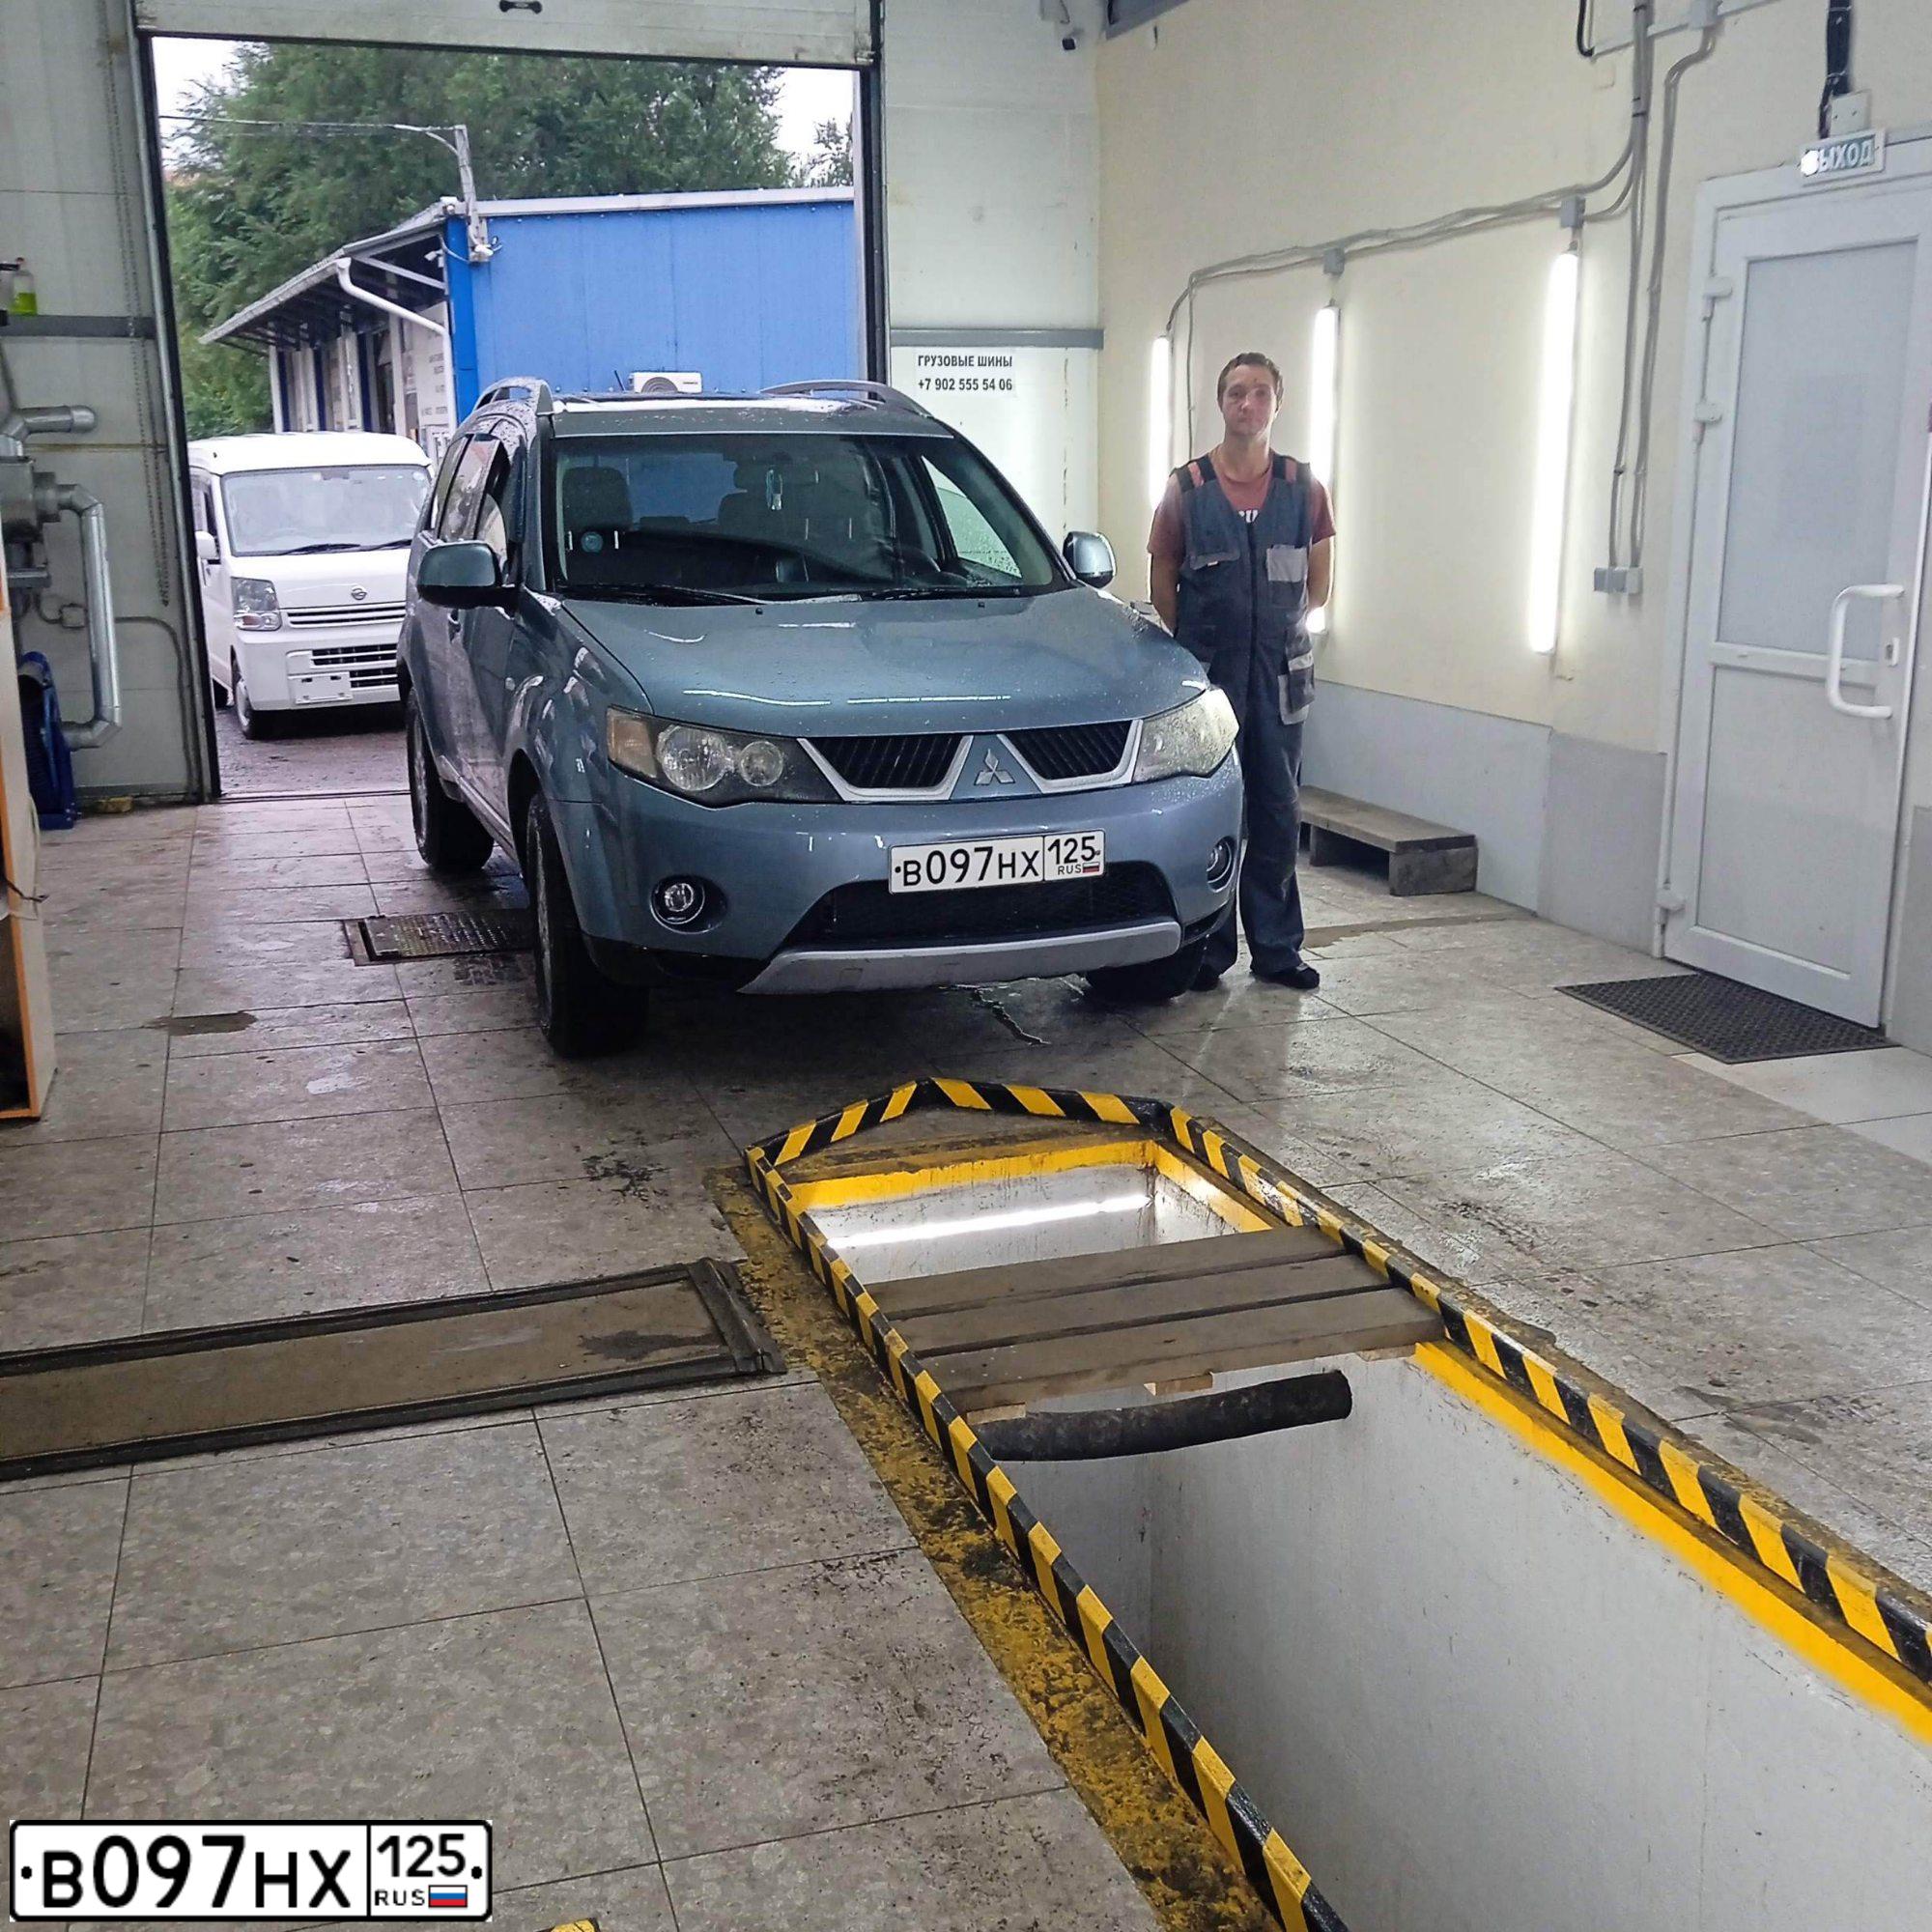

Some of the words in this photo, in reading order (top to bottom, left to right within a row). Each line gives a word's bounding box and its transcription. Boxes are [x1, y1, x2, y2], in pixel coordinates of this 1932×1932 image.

[1802, 138, 1873, 174] ЫХОД
[918, 355, 975, 367] ГРУЗОВЫЕ
[978, 355, 1012, 367] ШИНЫ
[919, 378, 931, 390] +7
[935, 378, 955, 390] 902
[958, 378, 980, 390] 555
[982, 378, 996, 390] 54
[999, 378, 1012, 390] 06
[1047, 836, 1095, 865] 125
[1058, 863, 1082, 876] RUS
